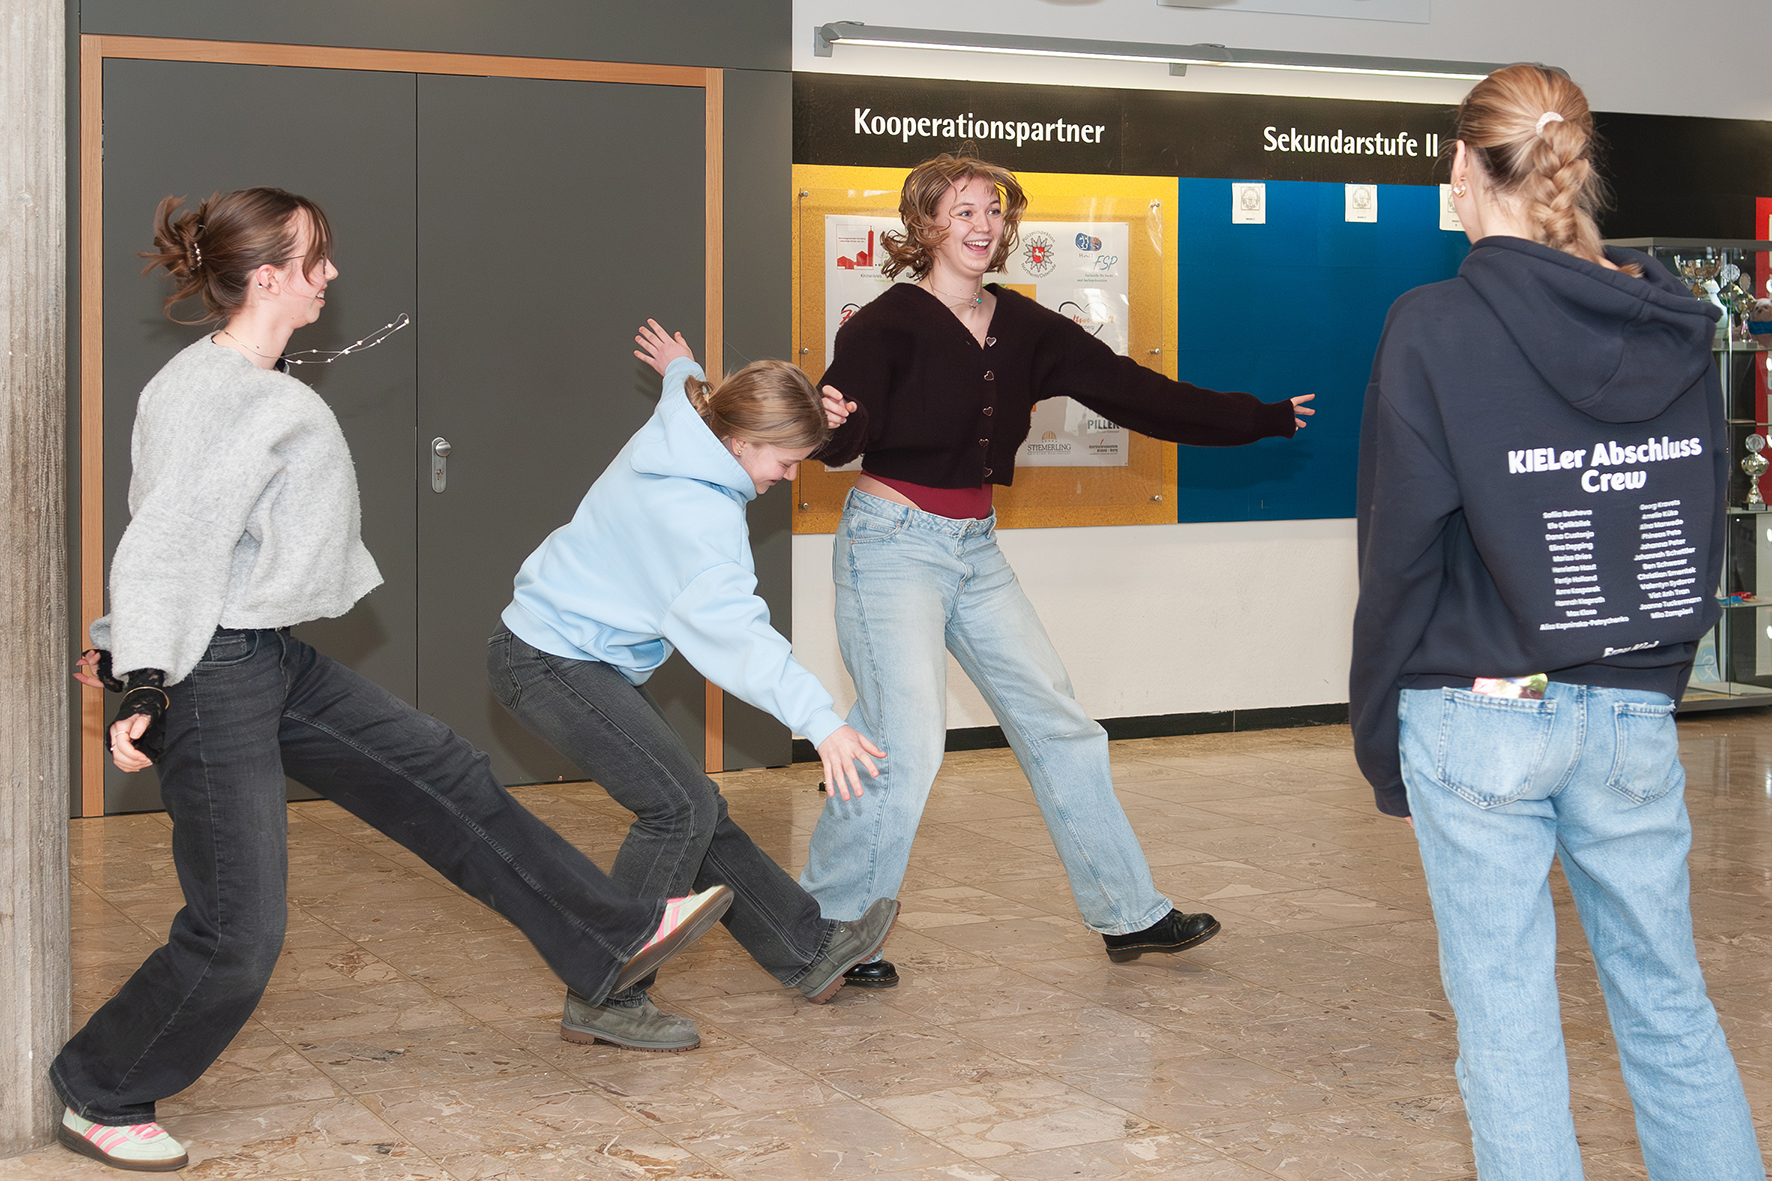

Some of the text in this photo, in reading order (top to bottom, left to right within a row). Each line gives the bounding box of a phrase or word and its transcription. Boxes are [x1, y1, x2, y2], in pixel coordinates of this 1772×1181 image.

[853, 107, 1105, 147] Kooperationspartner
[1263, 126, 1439, 157] Sekundarstufe II
[1093, 255, 1119, 271] FSP
[1027, 443, 1072, 452] STIEMERLING
[1508, 436, 1703, 474] KIELer Abschluss
[1581, 469, 1647, 493] Crew
